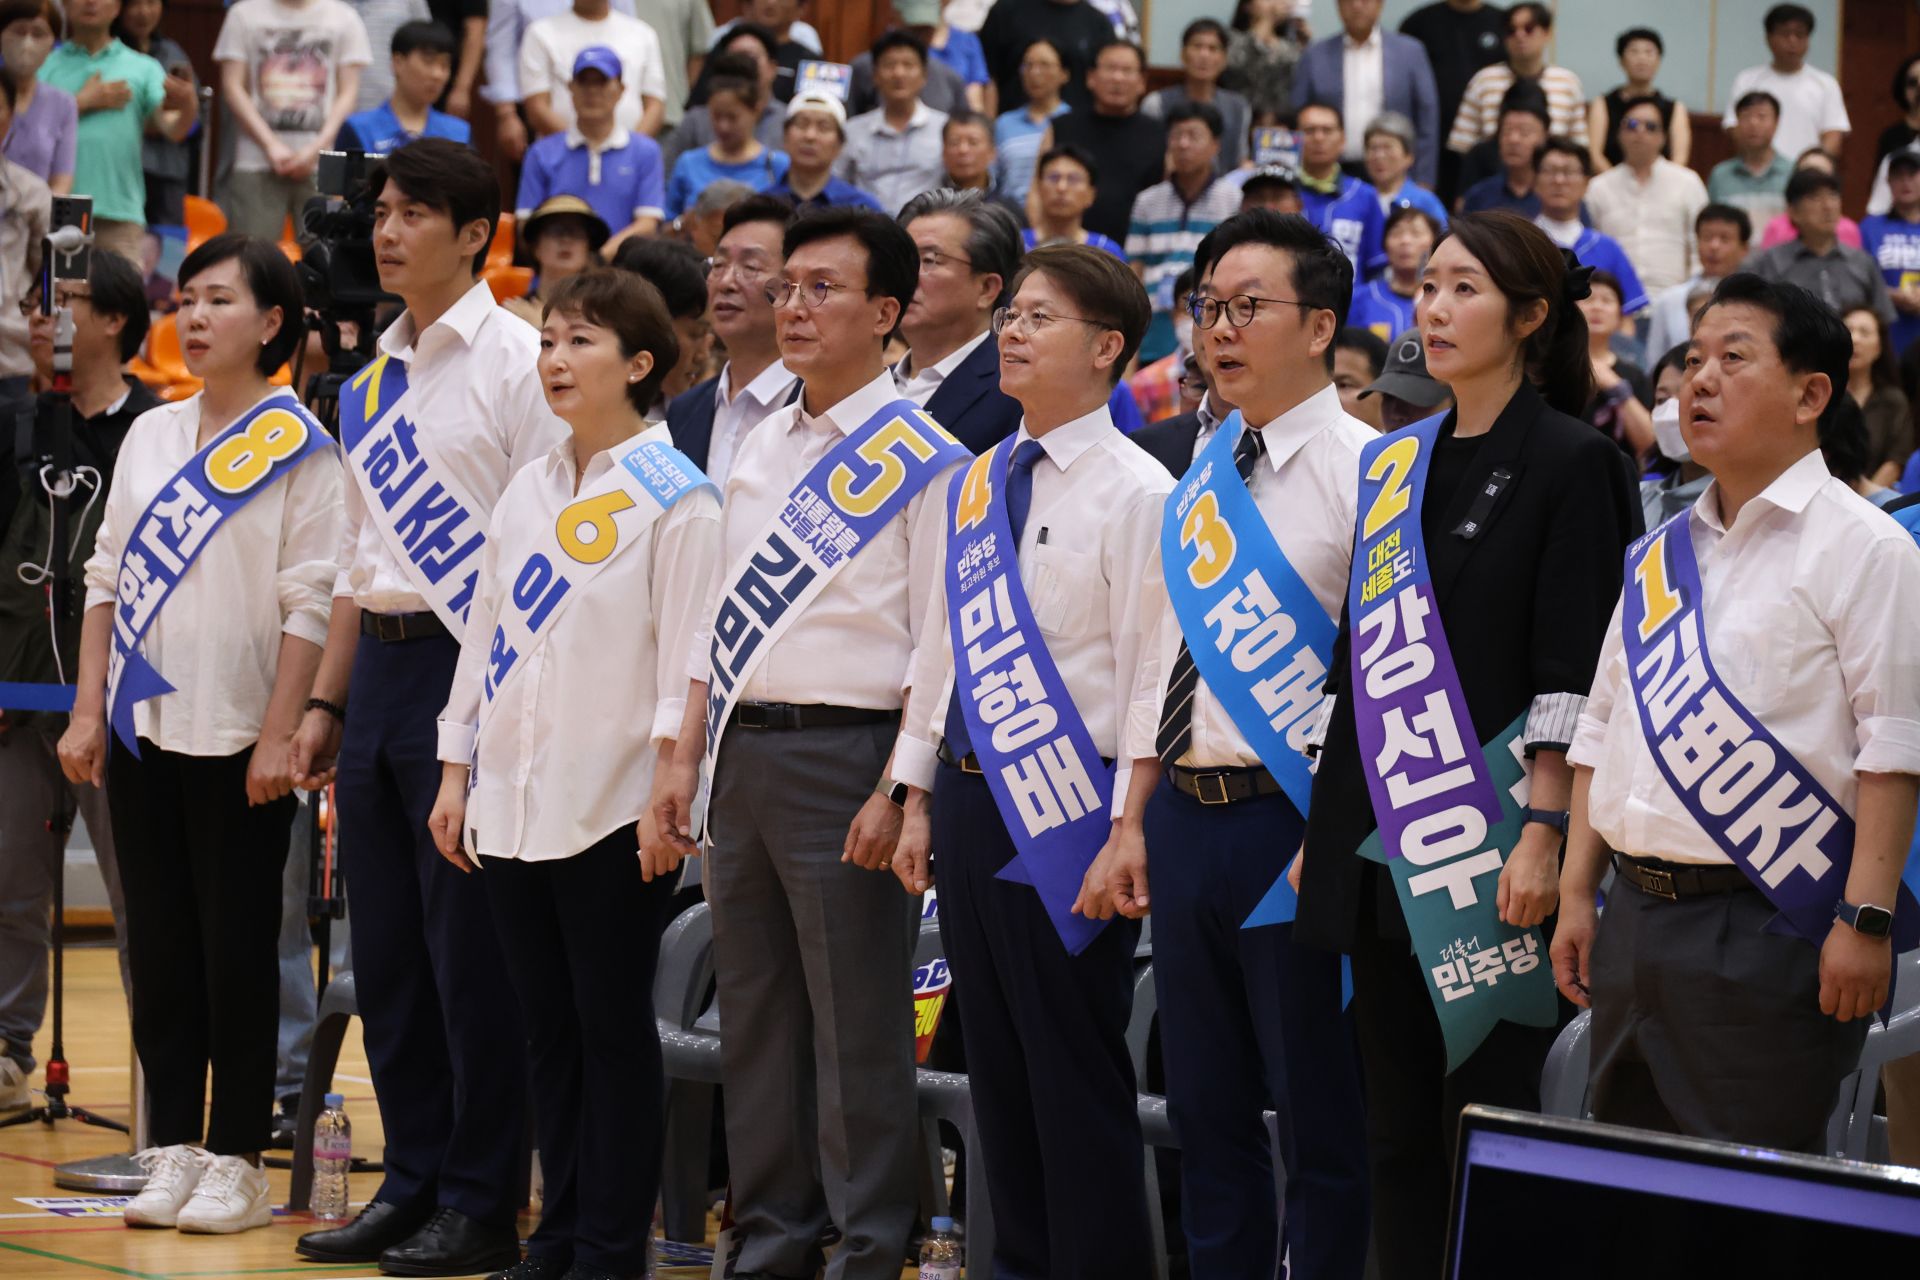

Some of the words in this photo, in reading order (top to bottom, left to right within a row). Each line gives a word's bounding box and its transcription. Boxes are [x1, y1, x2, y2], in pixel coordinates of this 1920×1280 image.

[352, 352, 390, 424] 7
[204, 407, 309, 494] 8
[827, 415, 938, 517] 5
[956, 446, 997, 535] 4
[1177, 461, 1213, 521] 민주당
[1363, 436, 1420, 541] 2
[362, 414, 487, 625] 한준
[555, 488, 637, 564] 6
[793, 485, 861, 555] 대통령을
[957, 532, 997, 581] 민주당
[1180, 490, 1237, 589] 3
[1369, 528, 1401, 573] 대전
[960, 567, 987, 594] 최고위원
[987, 555, 1001, 573] 후보
[1360, 546, 1416, 606] 세종도!
[1635, 531, 1683, 644] 1
[960, 573, 1103, 839] 민형배
[1203, 568, 1330, 775] 정봉
[1358, 584, 1504, 910] 강선우
[1636, 608, 1840, 890] 김병주
[1431, 934, 1540, 1002] 민주당
[1439, 935, 1481, 962] 더불어
